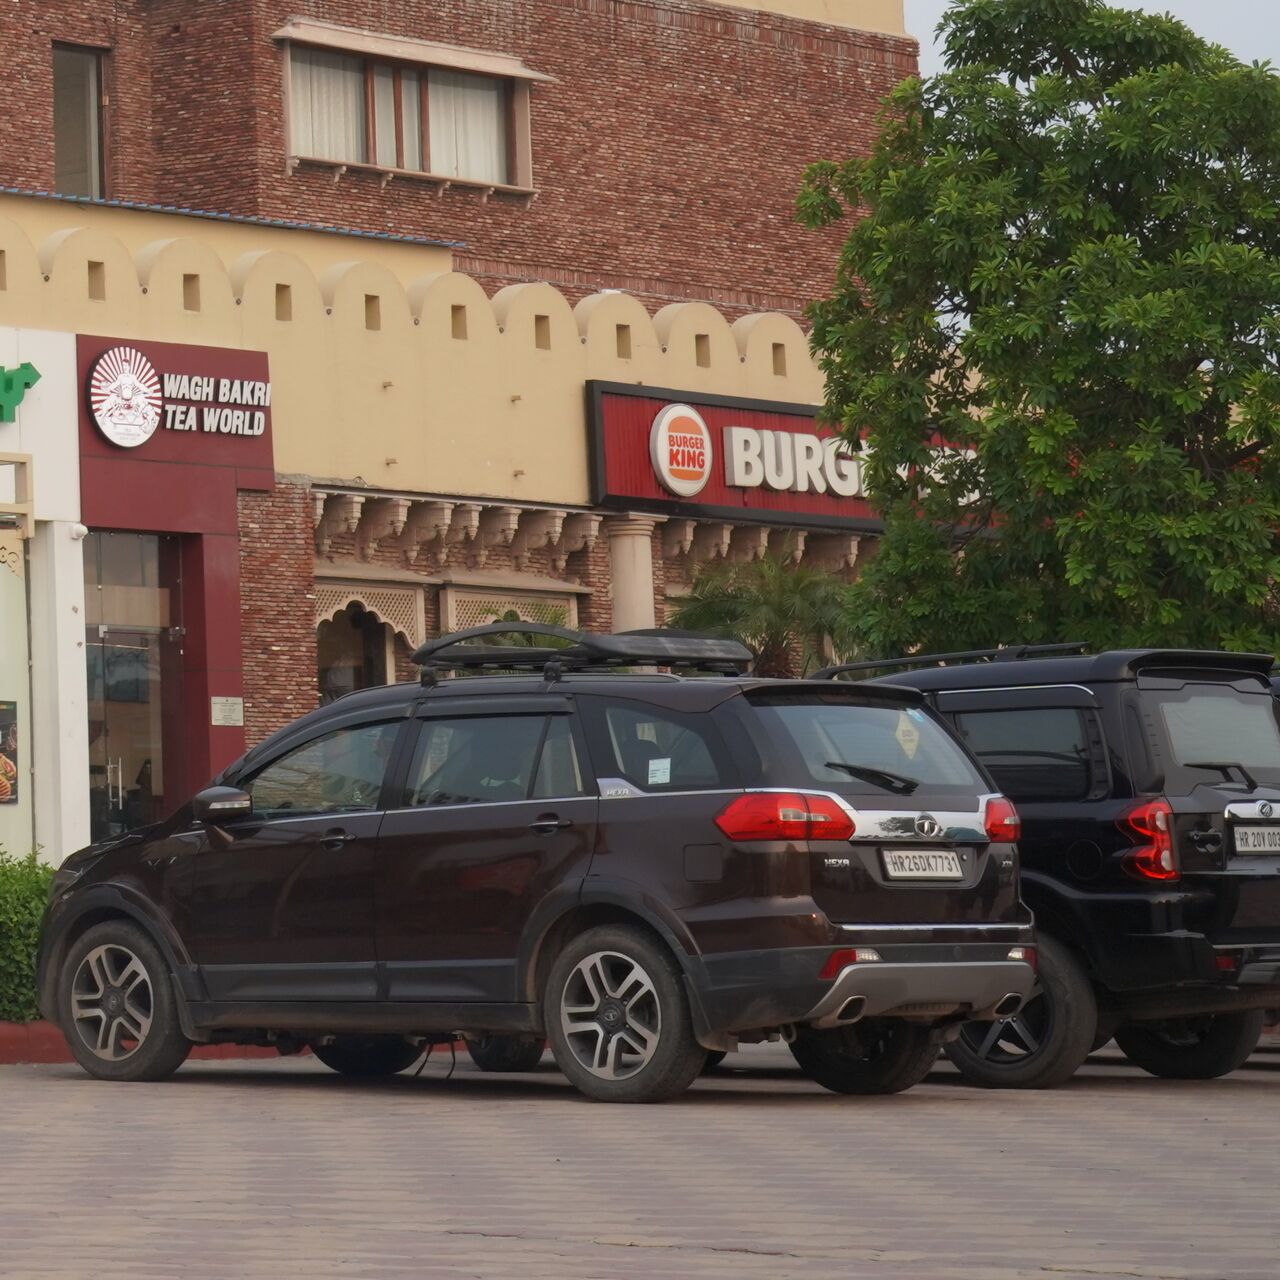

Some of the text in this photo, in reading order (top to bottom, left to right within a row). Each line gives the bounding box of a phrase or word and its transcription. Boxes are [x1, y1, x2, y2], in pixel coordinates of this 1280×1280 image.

[162, 373, 272, 407] WAGH BAKRI
[164, 404, 266, 436] TEA WORLD
[668, 434, 705, 450] BURGER
[669, 448, 705, 469] KING
[723, 426, 872, 498] BURG
[824, 858, 850, 867] HEXA
[891, 853, 960, 873] HR26DK7731
